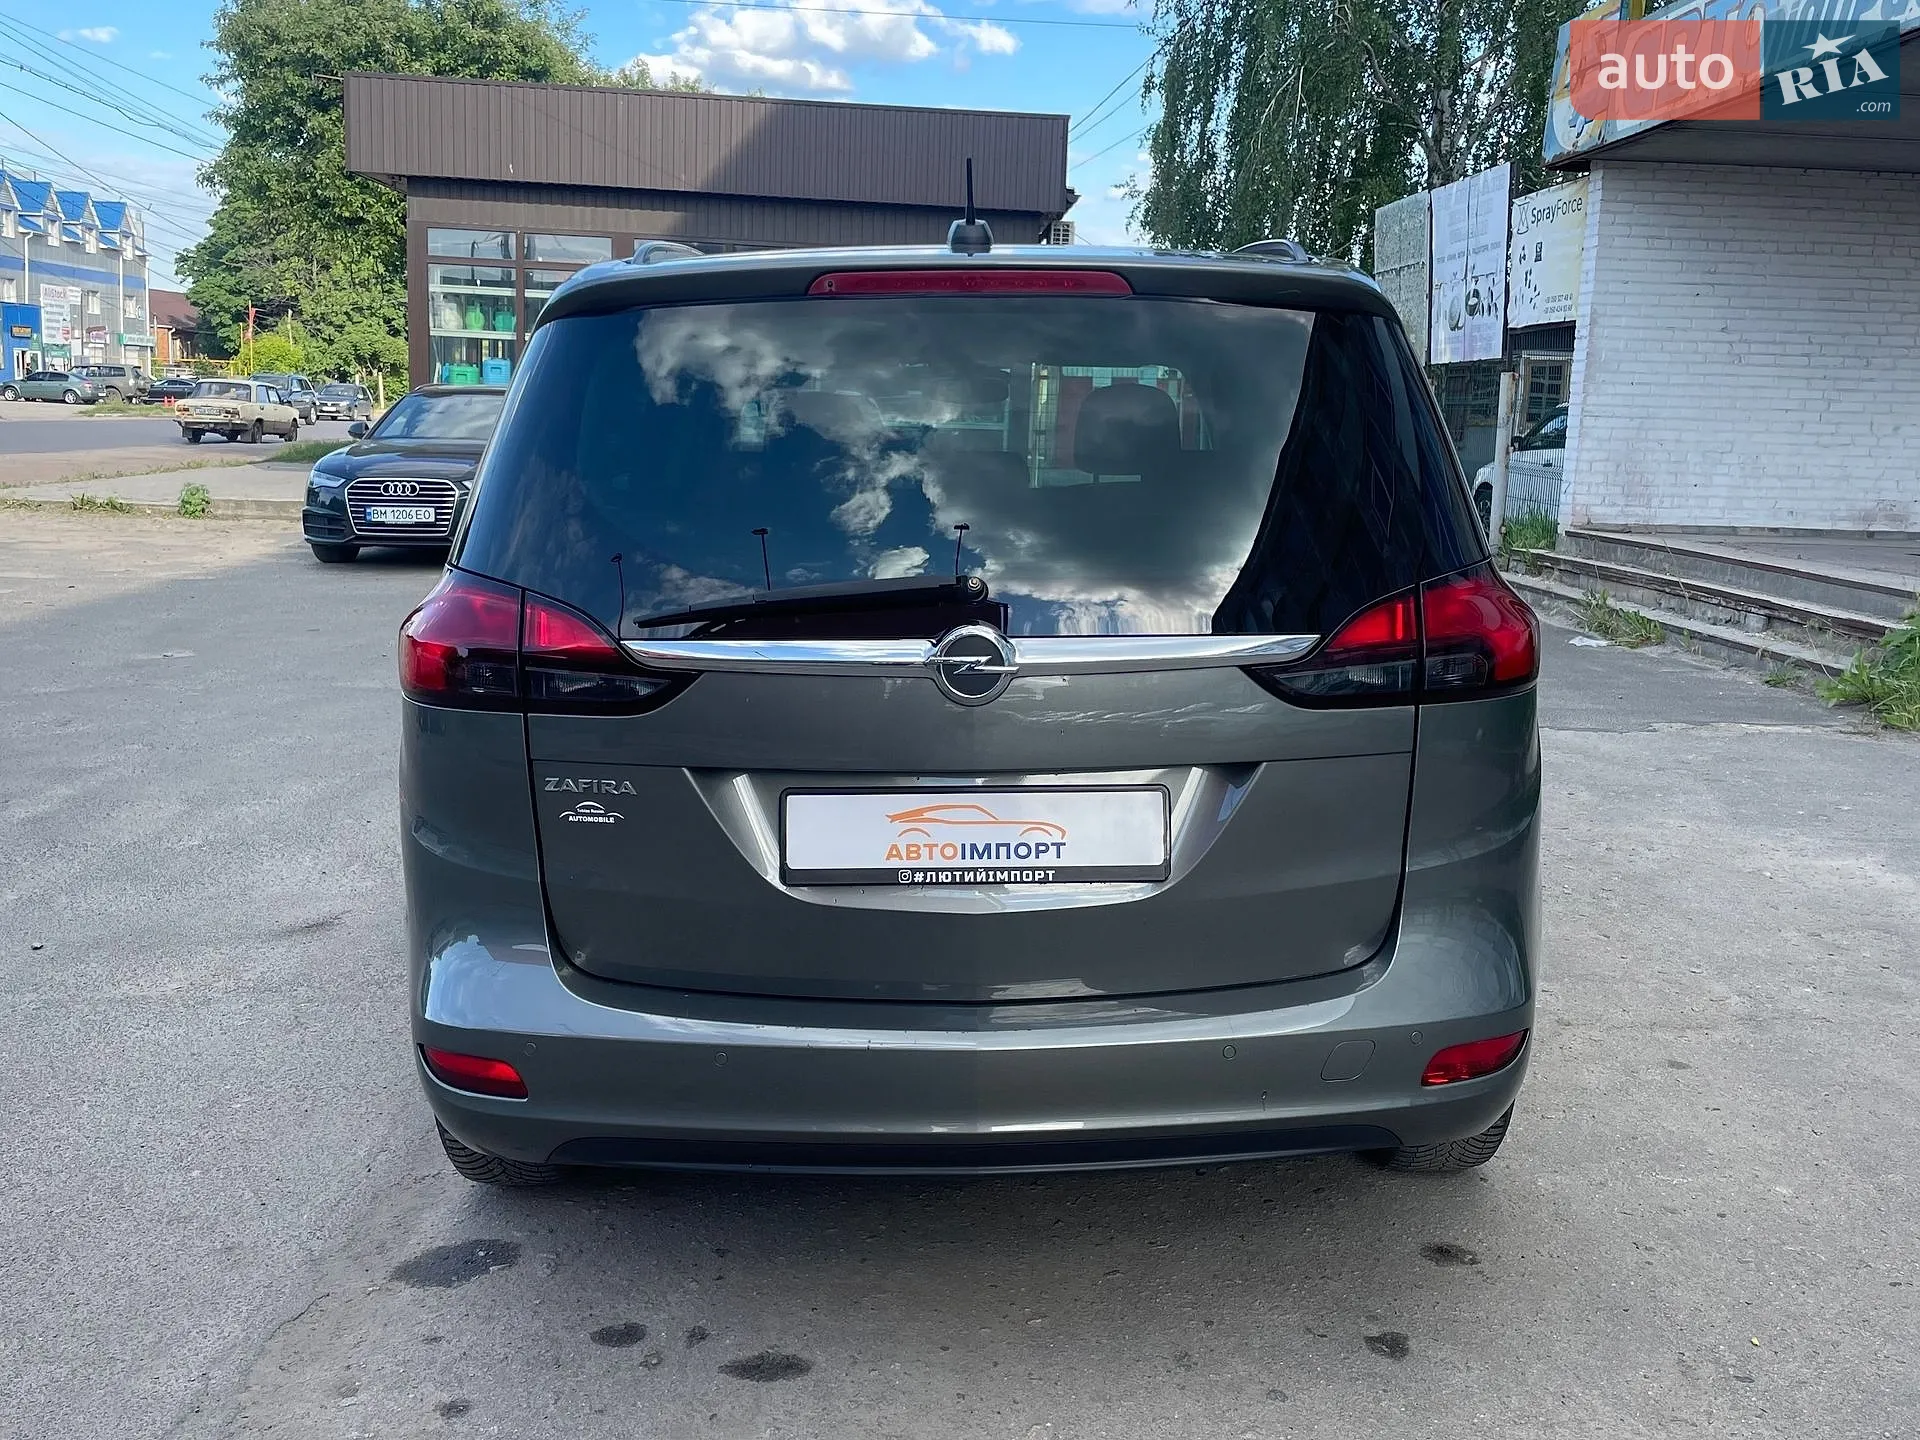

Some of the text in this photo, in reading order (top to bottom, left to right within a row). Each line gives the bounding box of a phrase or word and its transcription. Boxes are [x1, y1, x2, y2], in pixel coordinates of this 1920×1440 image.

[1531, 197, 1583, 227] SprayForce
[372, 509, 431, 520] BM 1206 EO
[544, 777, 638, 795] ZAFIRA
[885, 842, 1067, 861] АВТОІМПОРТ
